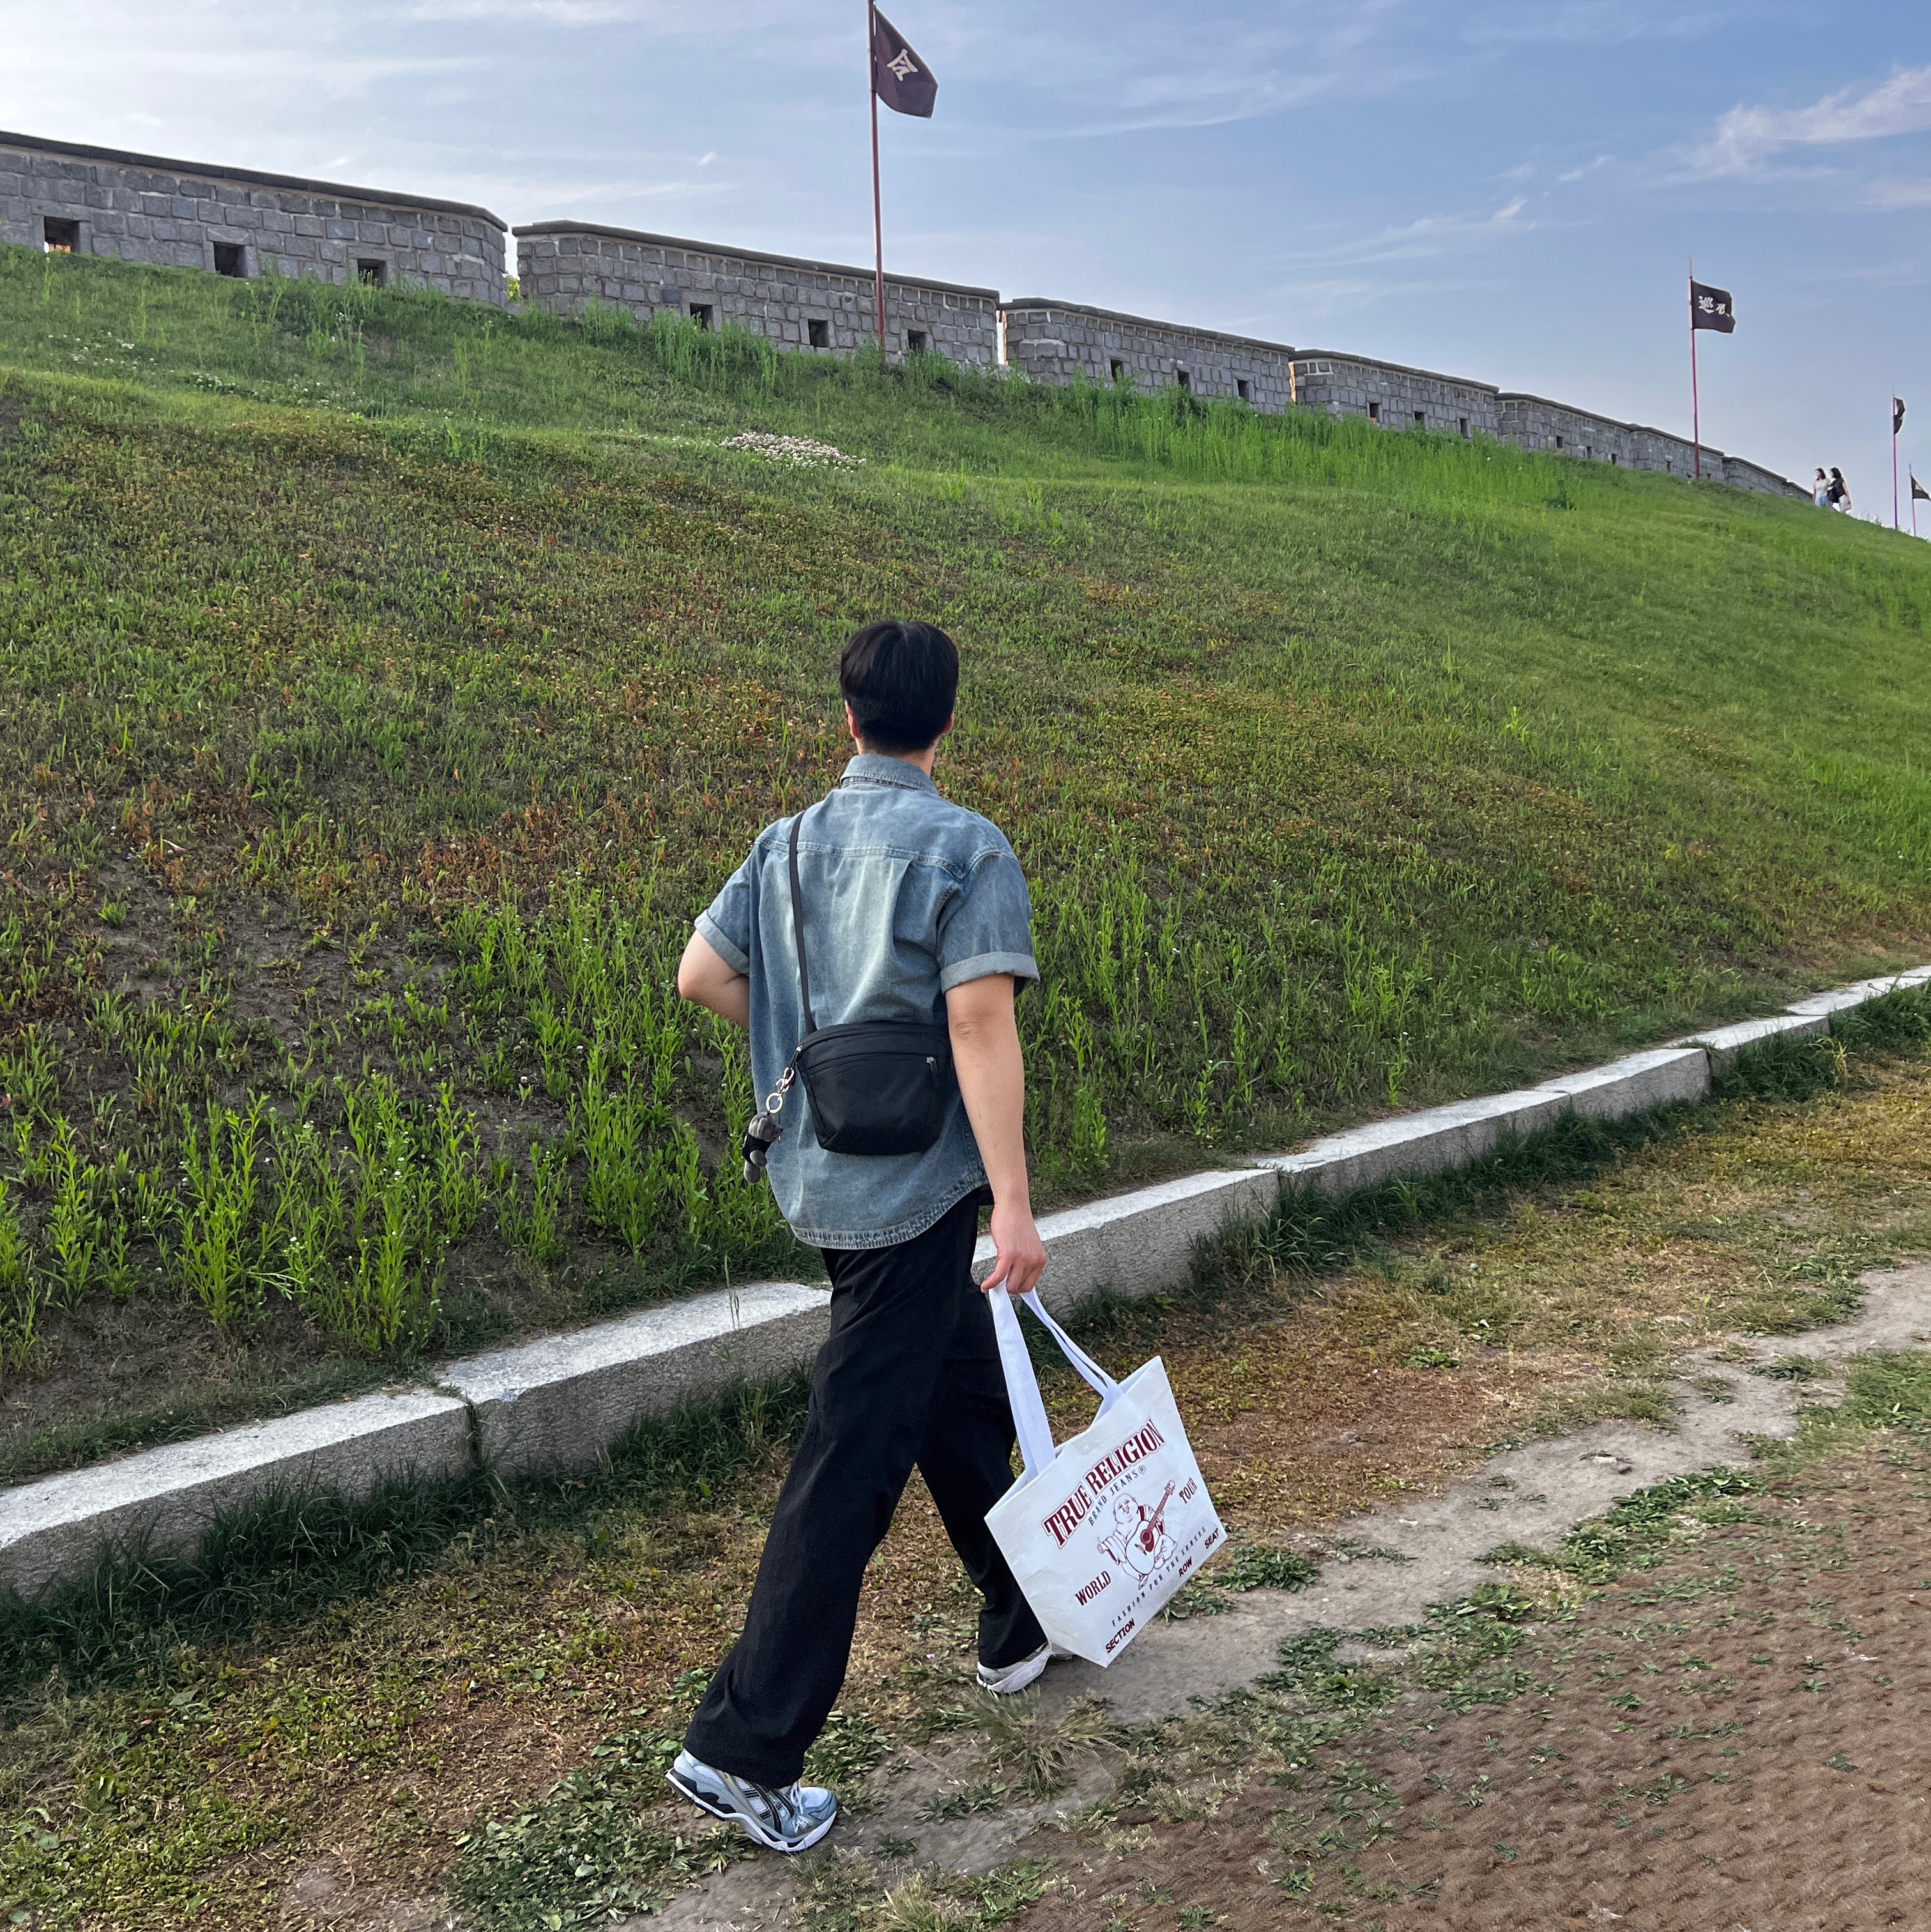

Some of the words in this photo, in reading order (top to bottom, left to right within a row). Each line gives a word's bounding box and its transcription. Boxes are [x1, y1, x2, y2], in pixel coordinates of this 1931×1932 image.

[1042, 1484, 1093, 1548] TRUE
[1085, 1417, 1165, 1496] RELIGION
[1074, 1571, 1111, 1606] WORLD
[1179, 1477, 1198, 1504] TOUR
[1088, 1495, 1107, 1526] BRAND
[1105, 1618, 1136, 1654] SECTION
[1178, 1556, 1193, 1578] ROW
[1204, 1528, 1219, 1549] SEAT
[1111, 1591, 1146, 1627] FASHION
